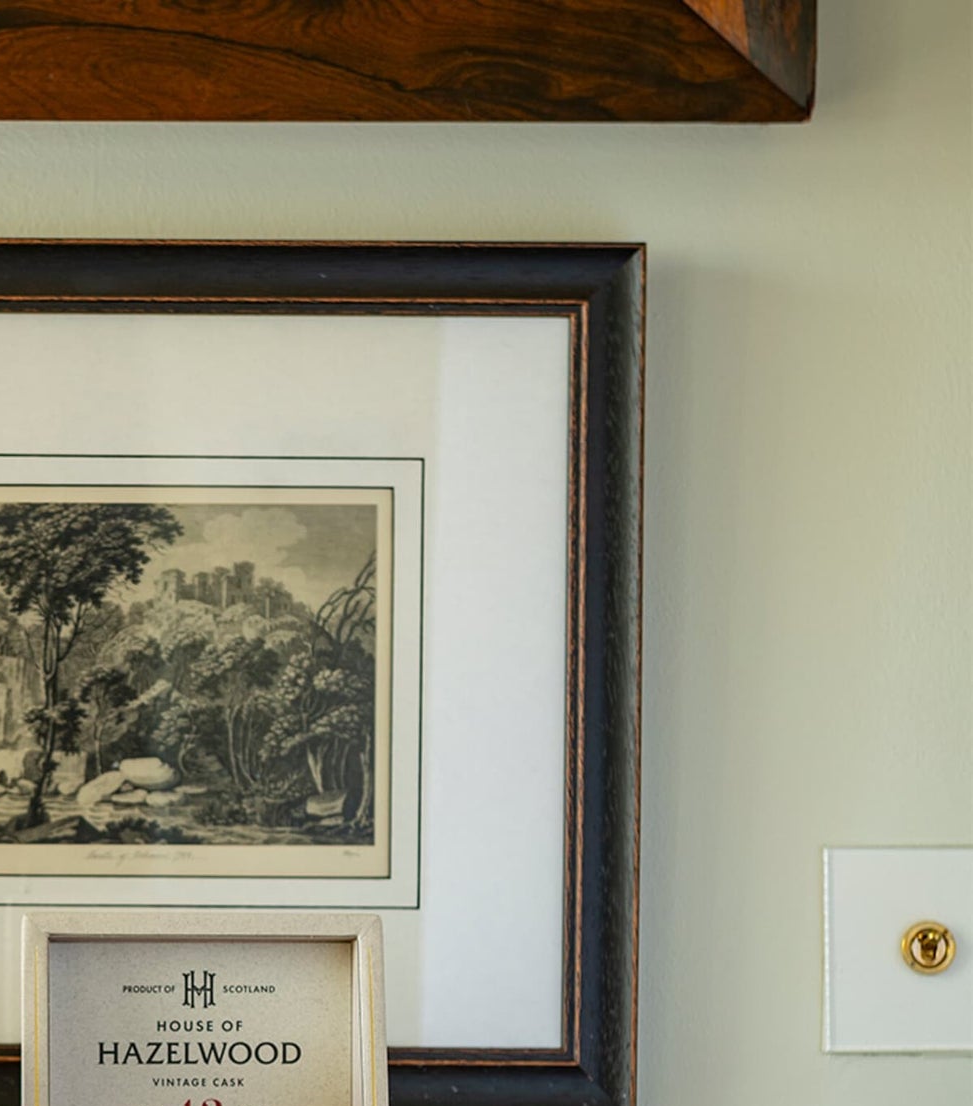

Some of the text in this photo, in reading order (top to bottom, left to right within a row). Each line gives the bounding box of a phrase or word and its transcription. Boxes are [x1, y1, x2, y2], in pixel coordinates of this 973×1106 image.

[157, 1021, 242, 1031] HOUSE OF
[98, 1042, 302, 1064] HAZELWOOD
[152, 1079, 244, 1087] VINTAGE CASK
